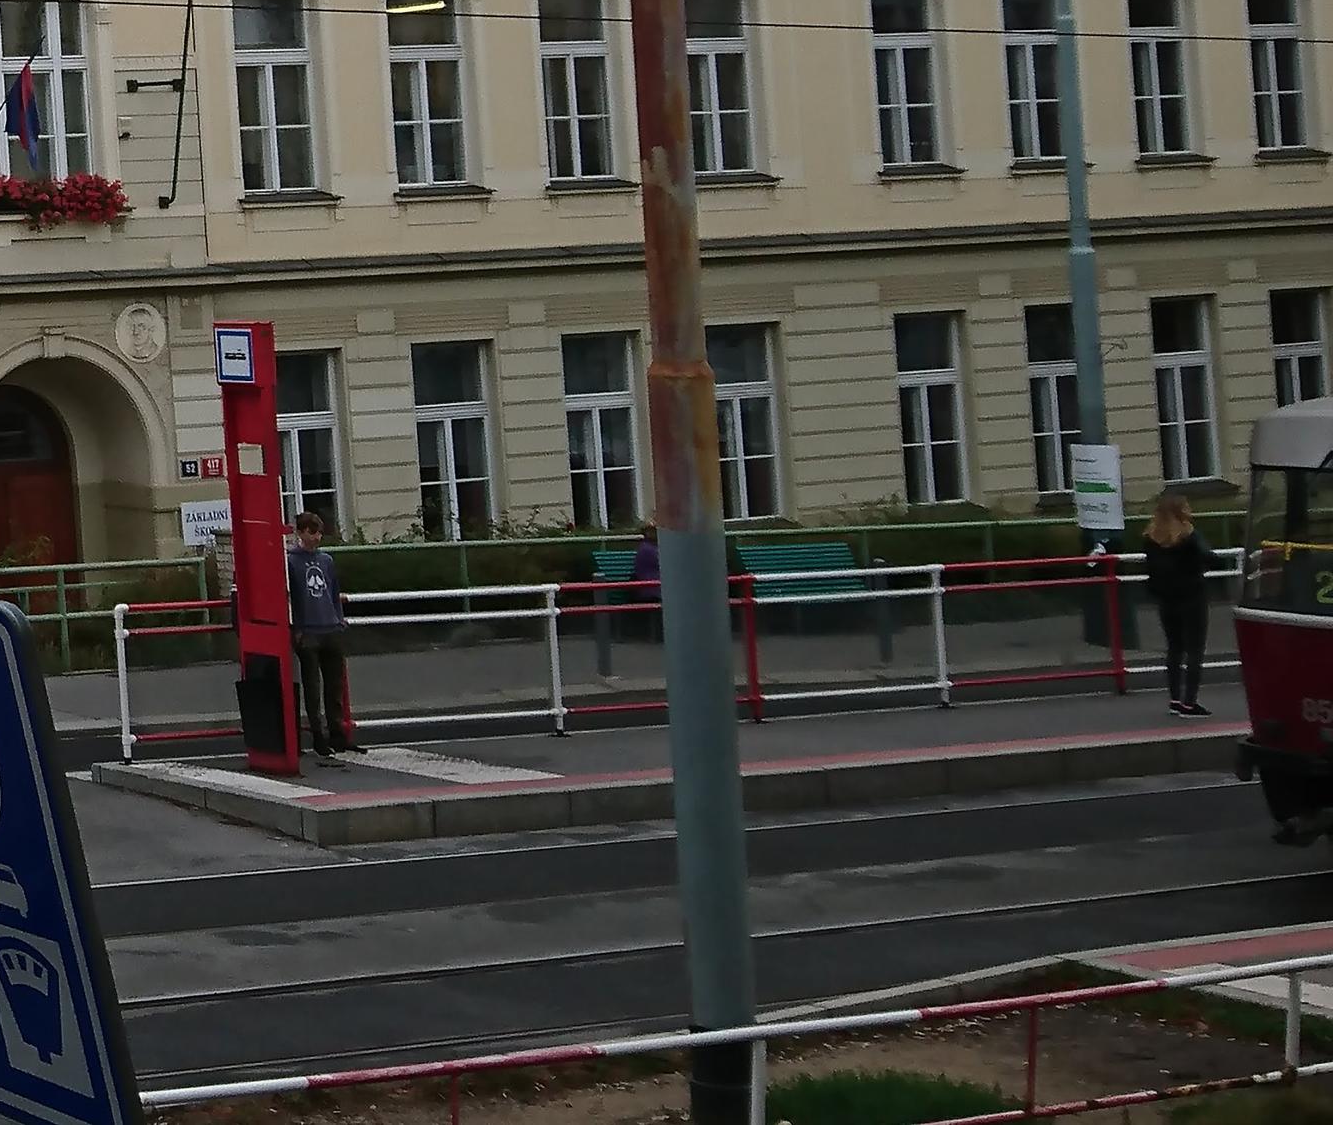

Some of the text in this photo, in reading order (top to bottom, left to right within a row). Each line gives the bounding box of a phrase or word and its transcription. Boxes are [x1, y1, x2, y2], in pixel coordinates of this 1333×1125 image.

[186, 463, 196, 474] 52
[207, 459, 220, 468] 417
[186, 508, 228, 523] ZÁKLADNÍ
[194, 525, 222, 537] ŠKO
